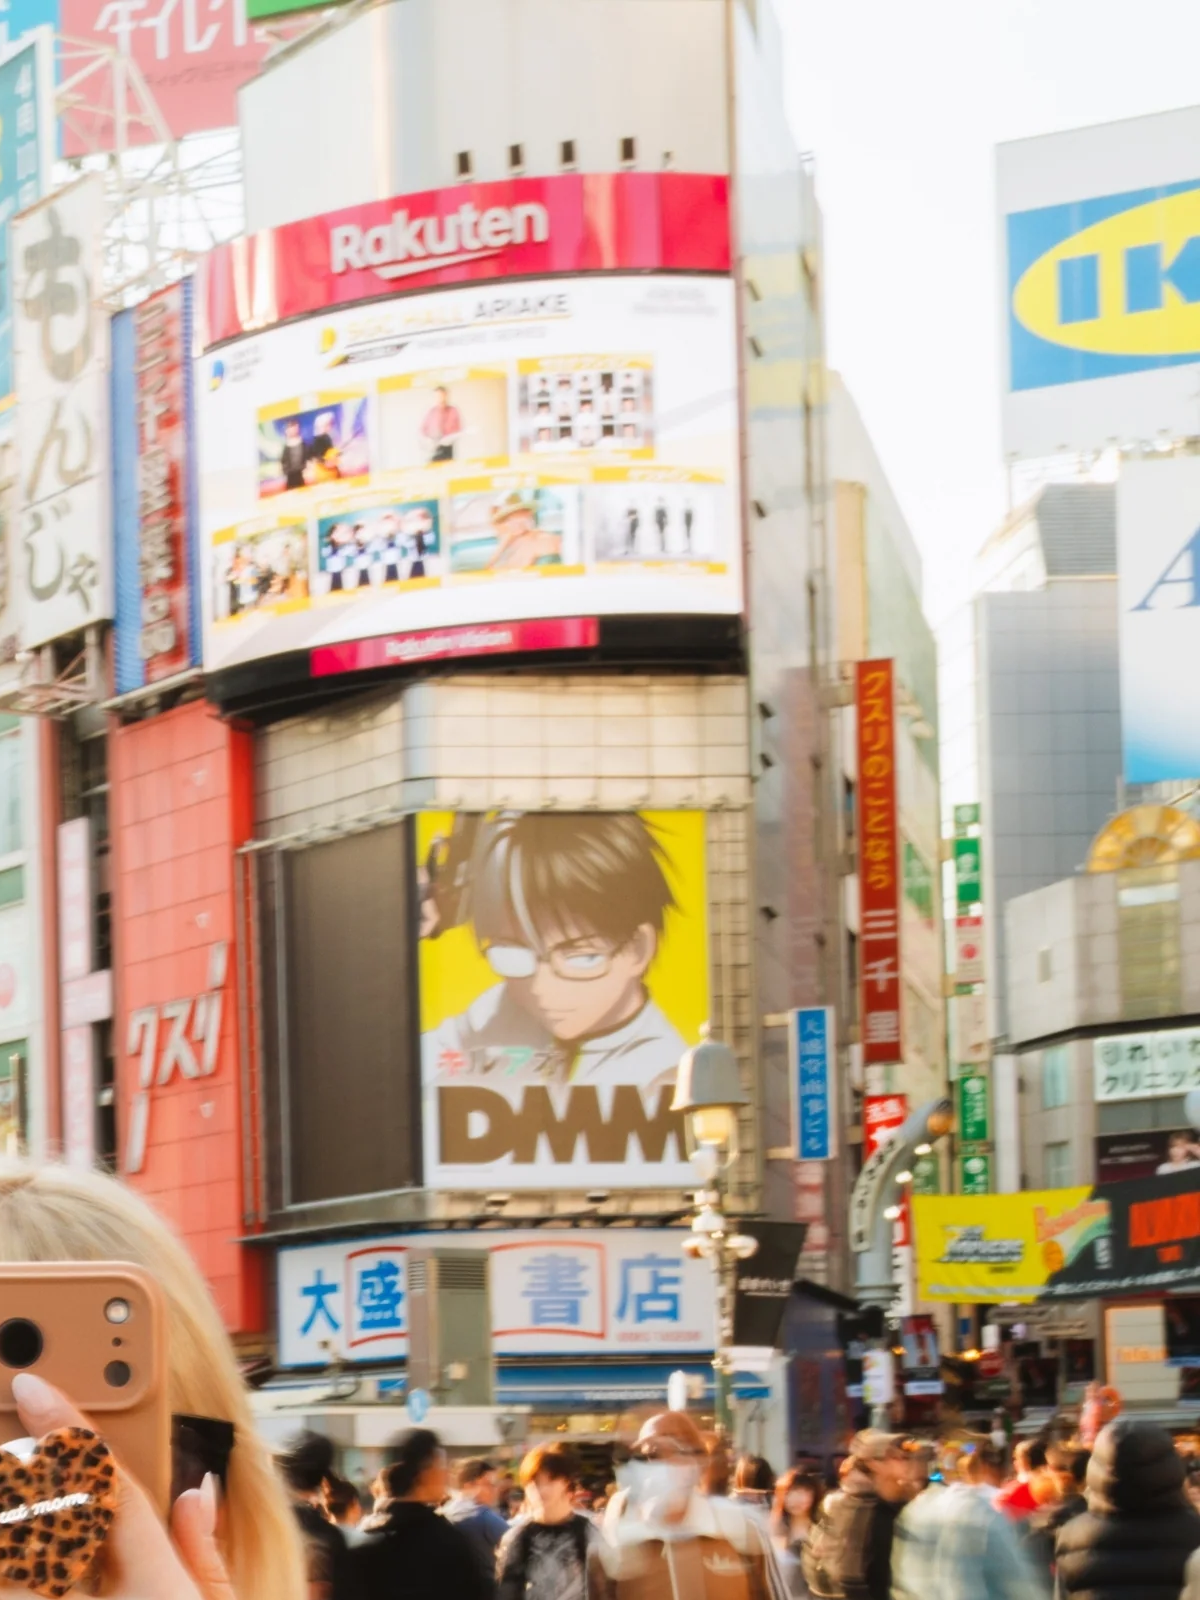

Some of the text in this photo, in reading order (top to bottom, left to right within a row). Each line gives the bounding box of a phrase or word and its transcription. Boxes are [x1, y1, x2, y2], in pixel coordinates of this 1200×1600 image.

[329, 201, 549, 277] Rakuten
[21, 207, 99, 611] もんじゃ
[438, 1084, 692, 1165] DMM
[300, 1254, 685, 1336] 大盛書店
